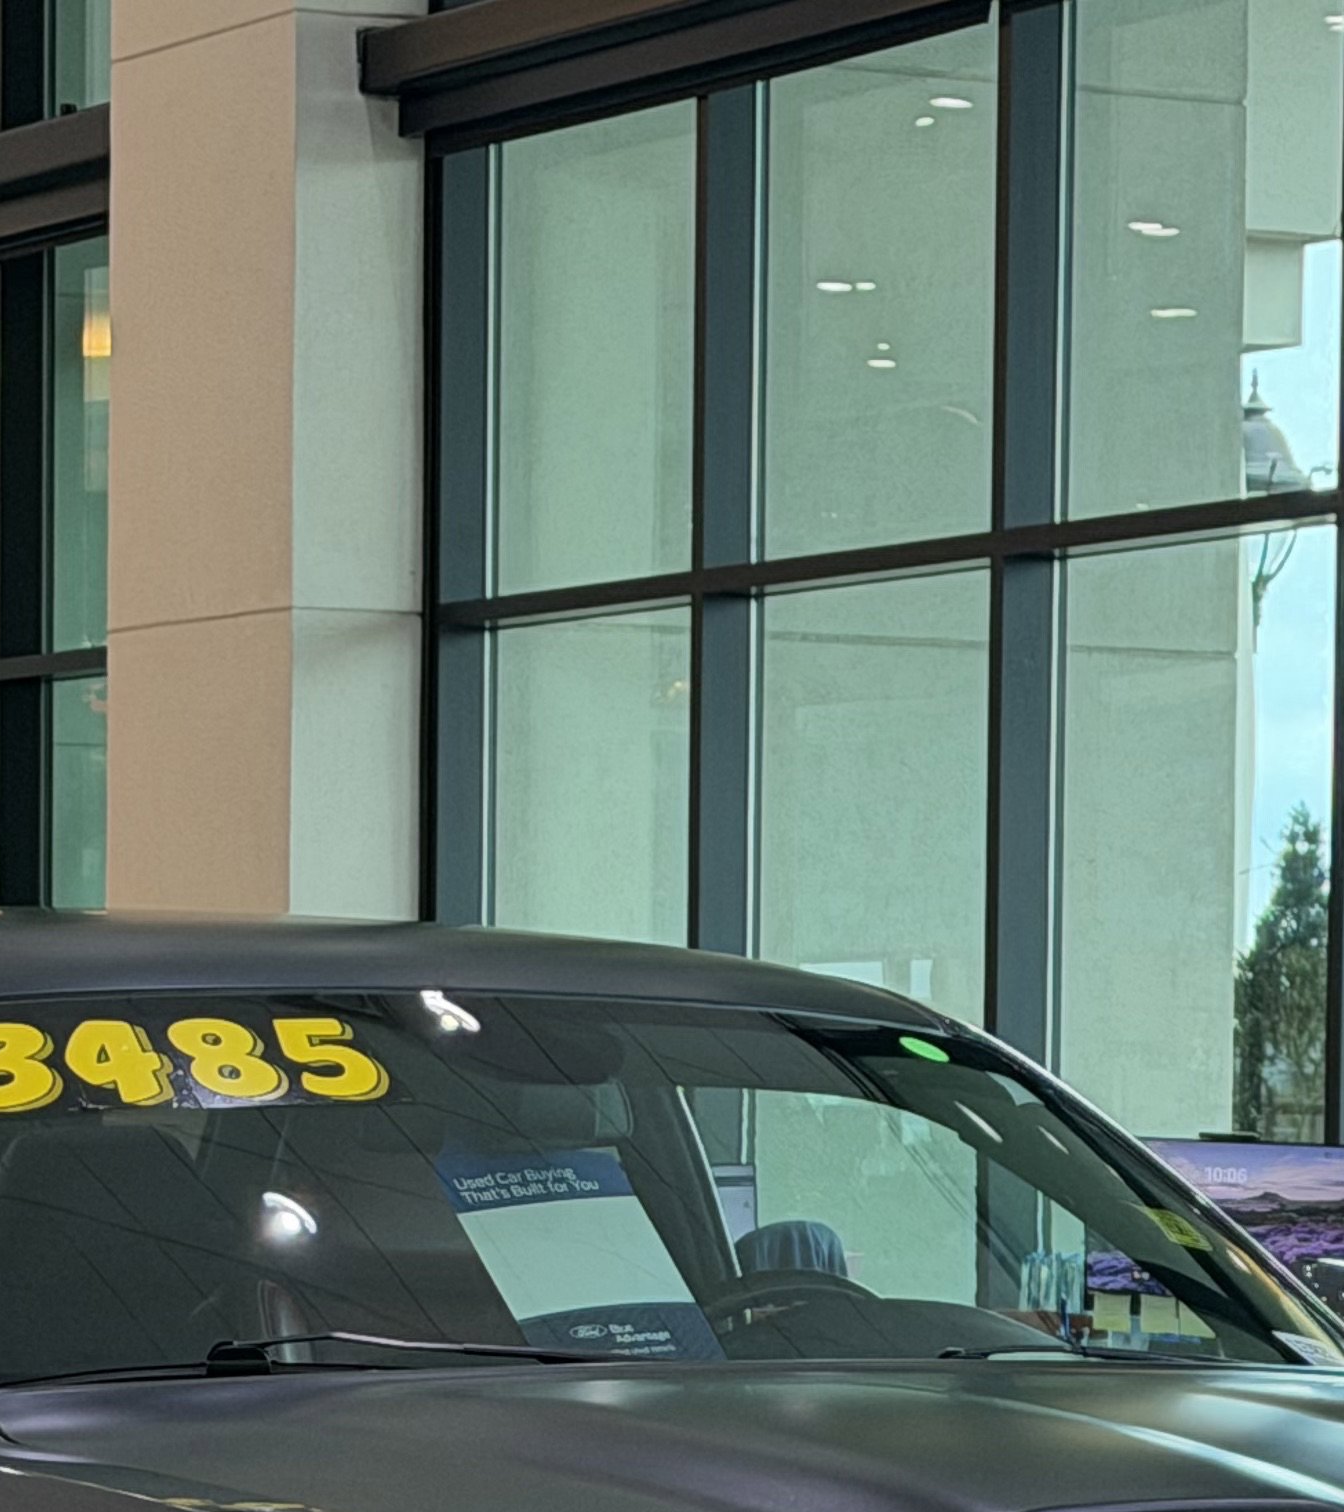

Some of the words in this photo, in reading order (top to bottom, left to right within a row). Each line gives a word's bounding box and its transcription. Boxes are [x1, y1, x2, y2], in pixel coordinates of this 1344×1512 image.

[453, 1174, 495, 1190] Used
[495, 1171, 523, 1185] Car
[546, 1180, 569, 1193] for
[569, 1177, 599, 1192] You
[1204, 1166, 1248, 1185] 10:06
